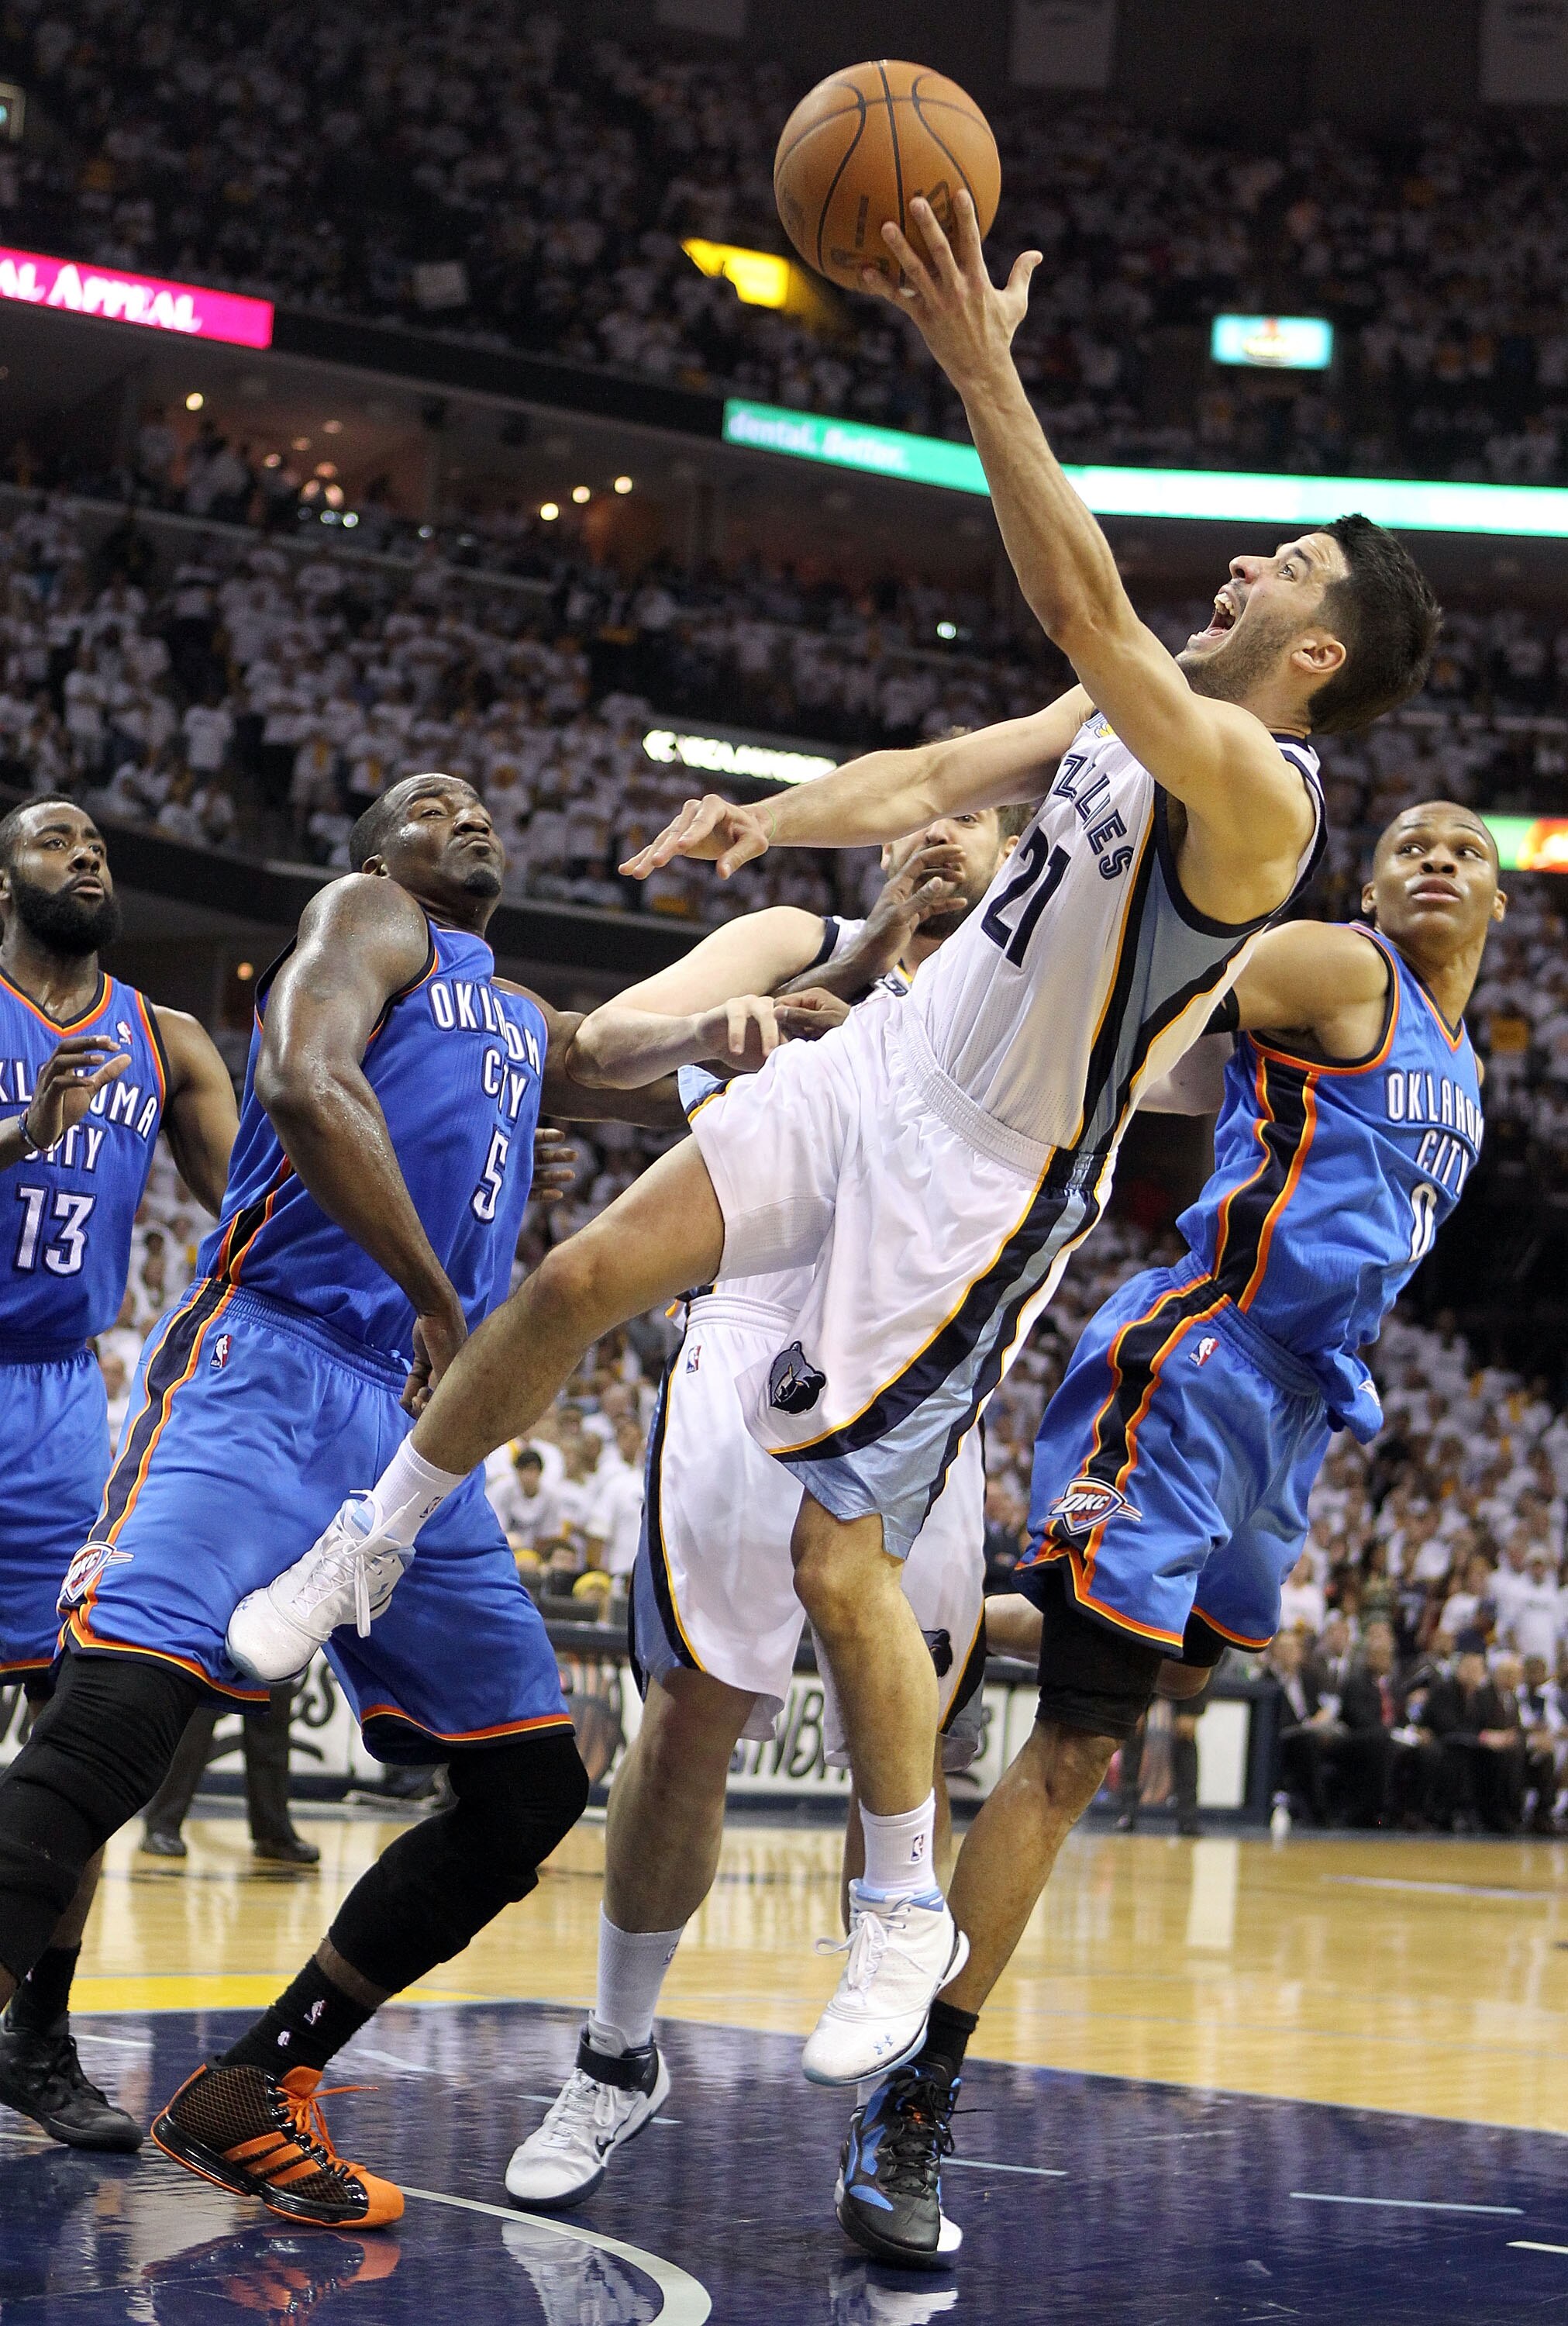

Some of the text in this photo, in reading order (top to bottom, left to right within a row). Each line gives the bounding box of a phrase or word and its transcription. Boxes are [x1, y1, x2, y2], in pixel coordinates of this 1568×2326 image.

[980, 824, 1072, 969] 21
[469, 1124, 509, 1223] 5
[16, 1183, 97, 1277] 13
[1408, 1181, 1439, 1263] 0
[1049, 1493, 1111, 1515] OKC
